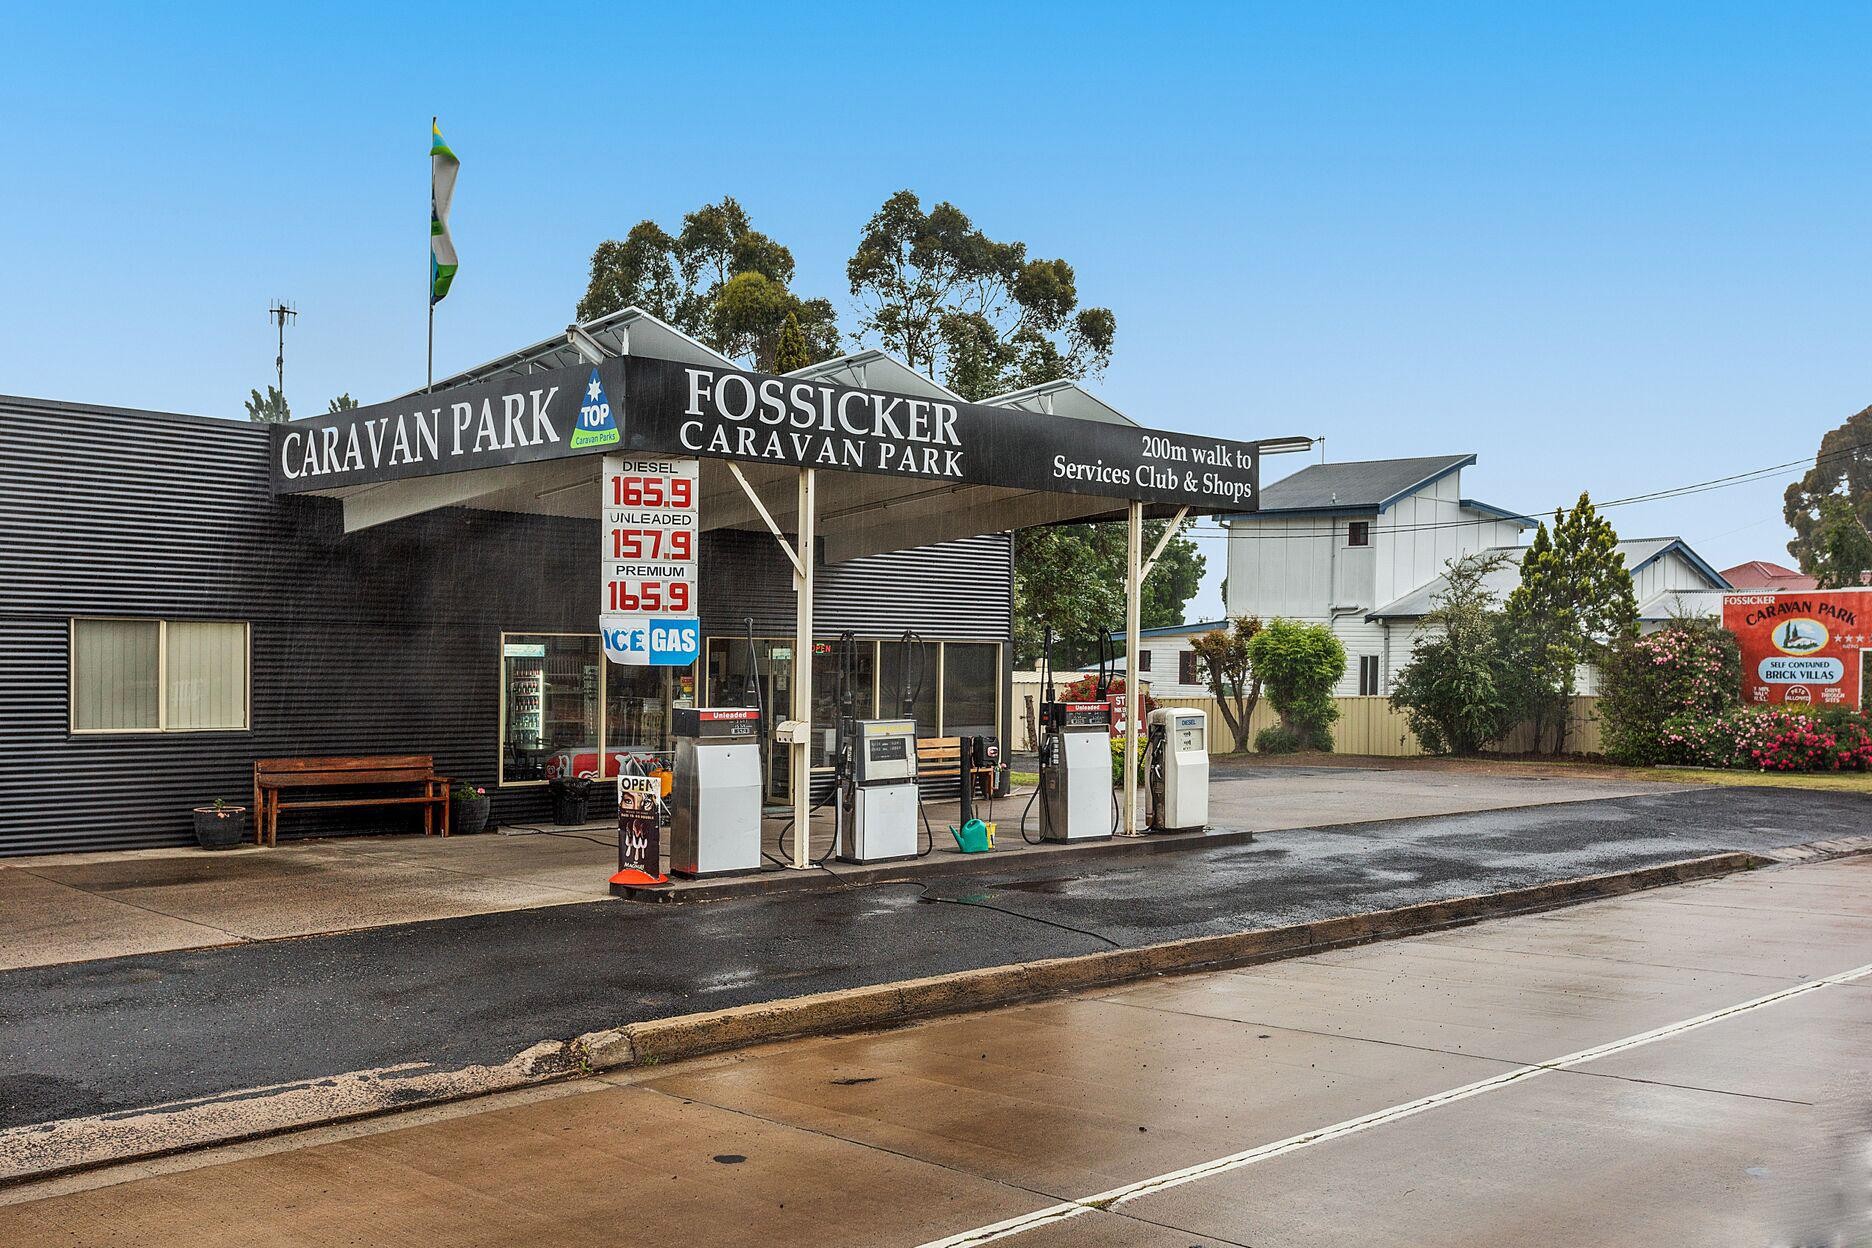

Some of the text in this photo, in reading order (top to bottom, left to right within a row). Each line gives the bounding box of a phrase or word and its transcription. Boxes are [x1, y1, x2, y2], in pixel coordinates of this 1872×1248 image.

[580, 403, 609, 428] TOP
[684, 367, 962, 447] FOSSICKER
[281, 386, 560, 479] CARAVAN PARK
[575, 432, 616, 446] Caravan Parks
[679, 420, 965, 479] CARAVAN PARK
[1141, 435, 1252, 470] 200m walk to
[622, 461, 679, 474] DIESEL
[1053, 453, 1253, 505] Services Club & Shops
[611, 475, 692, 508] 165.9
[610, 513, 692, 526] UNLEADED
[611, 528, 692, 560] 157.9
[616, 565, 685, 577] PREMIUM
[1724, 595, 1775, 605] FOSSICKER
[1746, 601, 1857, 626] CARAVAN PARK
[603, 629, 696, 652] ICE GAS
[1765, 671, 1834, 680] BRICK VILLAS
[713, 711, 747, 719] Unleaded
[621, 777, 654, 792] OPEN
